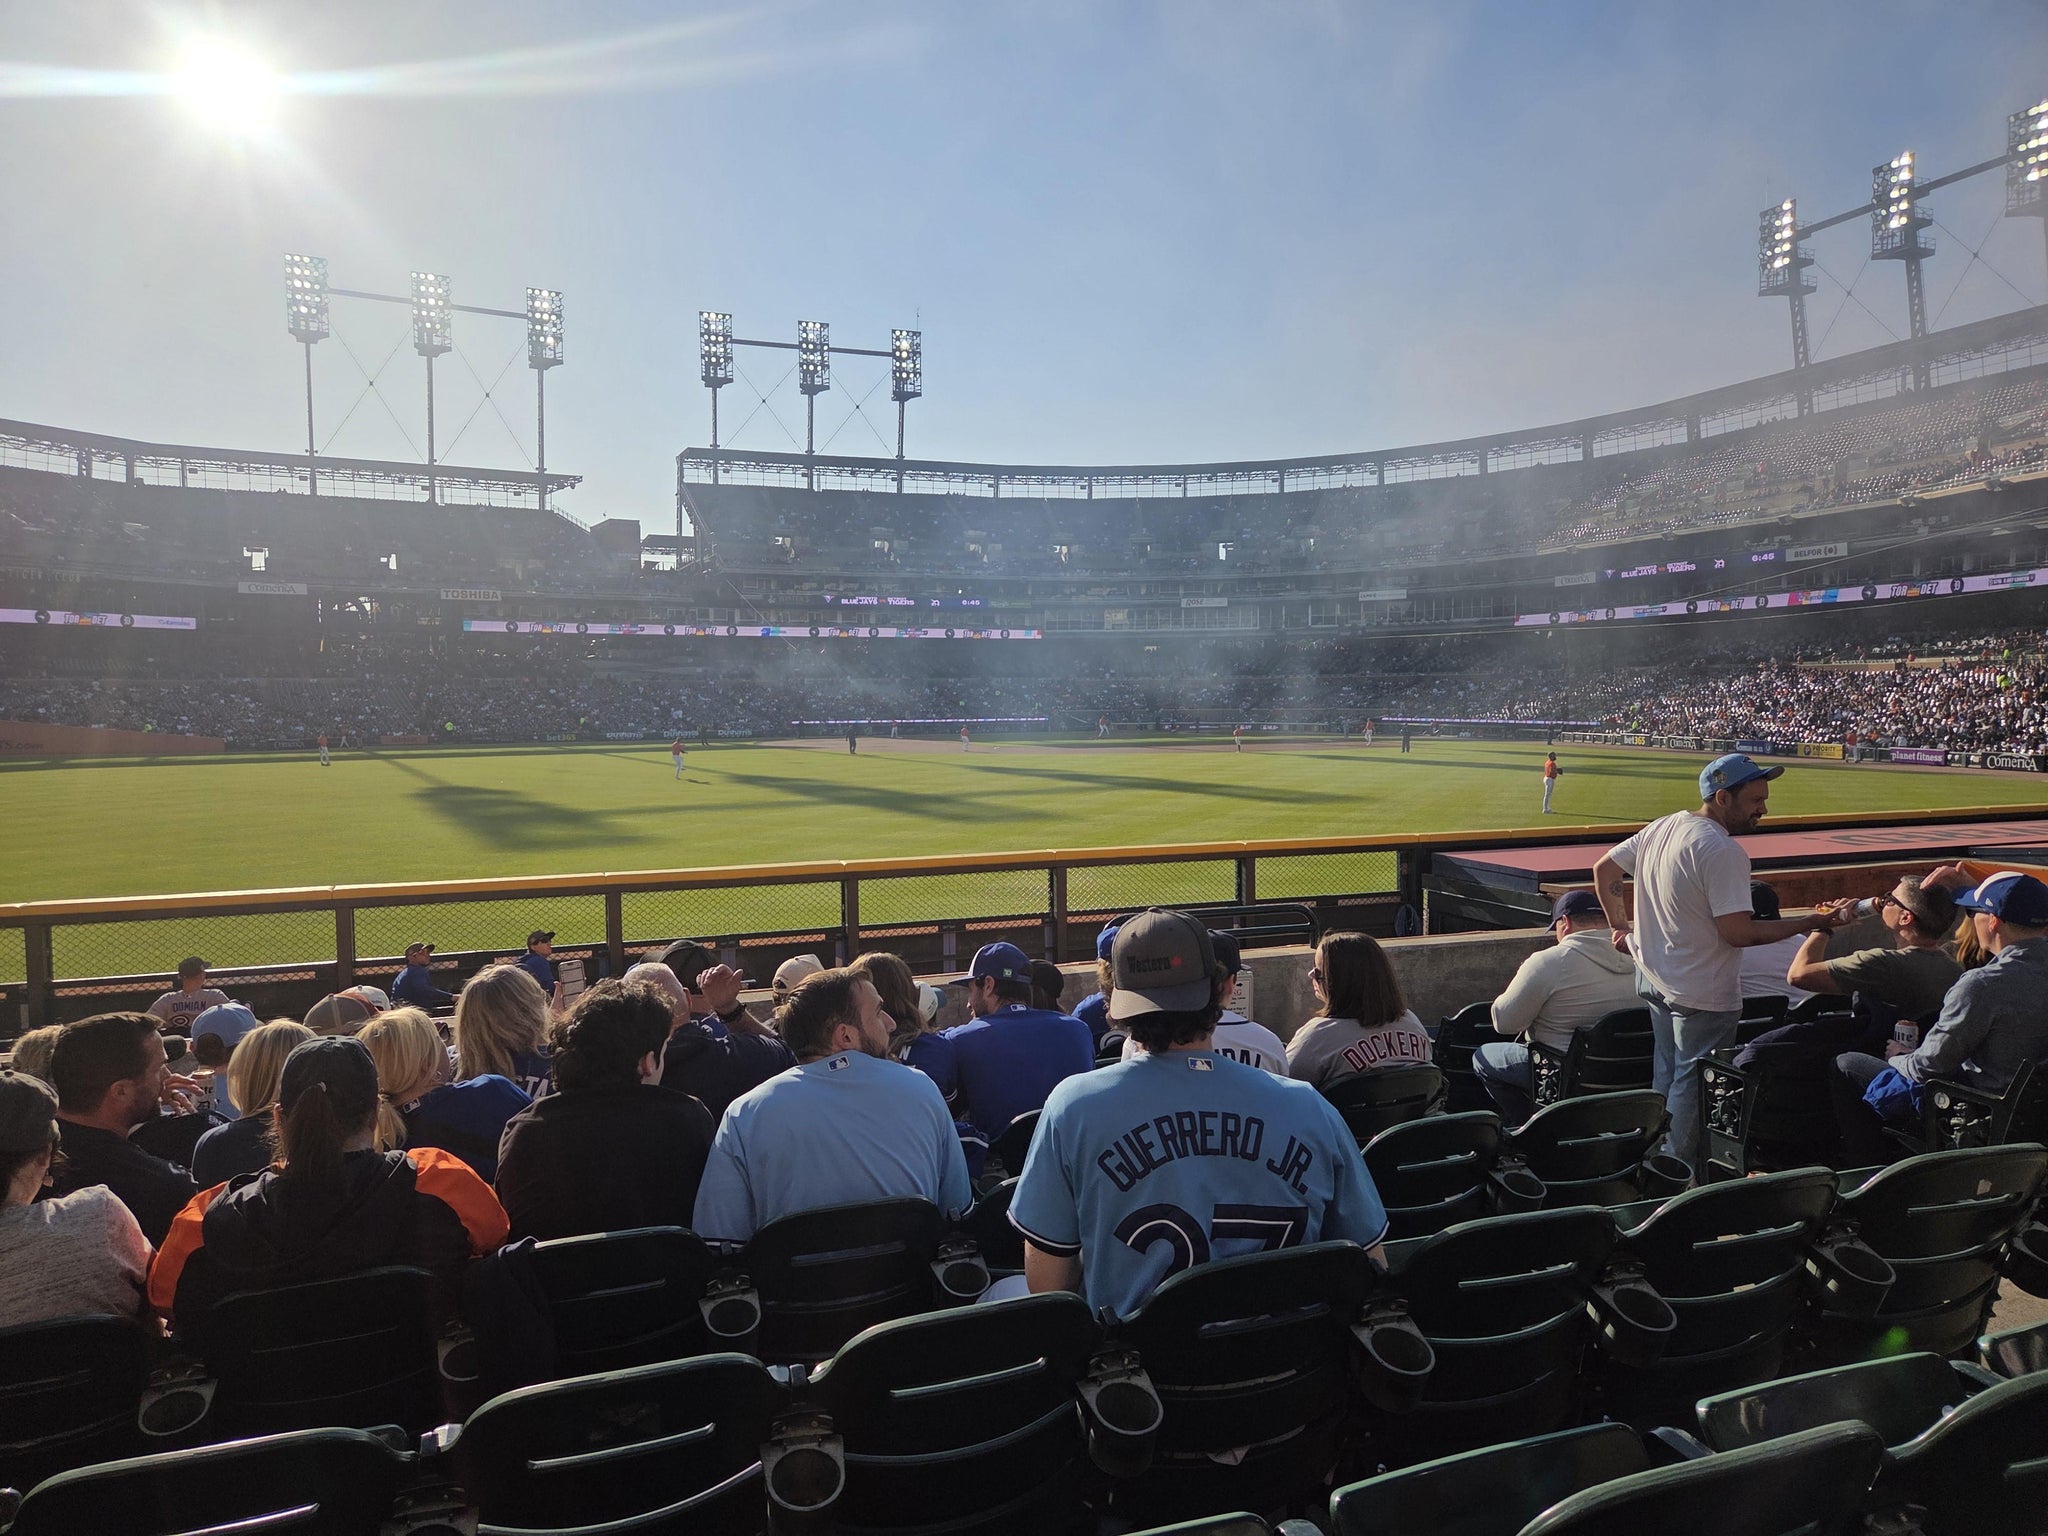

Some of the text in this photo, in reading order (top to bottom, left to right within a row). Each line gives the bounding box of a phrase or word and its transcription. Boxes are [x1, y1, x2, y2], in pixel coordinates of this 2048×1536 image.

[1752, 552, 1775, 563] 6:45
[1794, 548, 1822, 559] BELFOR
[1667, 563, 1697, 573] TIGERS
[443, 589, 499, 600] TOSHIBA
[1890, 585, 1907, 597] TOR
[1920, 582, 1938, 595] DET
[1708, 599, 1721, 611] TOR
[1731, 598, 1744, 610] DET
[64, 614, 108, 625] TOR DET
[1623, 736, 1646, 745] bet365
[1890, 751, 1943, 763] planet fitness
[1126, 955, 1171, 974] Western
[172, 1001, 207, 1013] DOMIAN
[1341, 1031, 1429, 1074] DOCKERY
[1097, 1111, 1313, 1195] GUERRERO JR.
